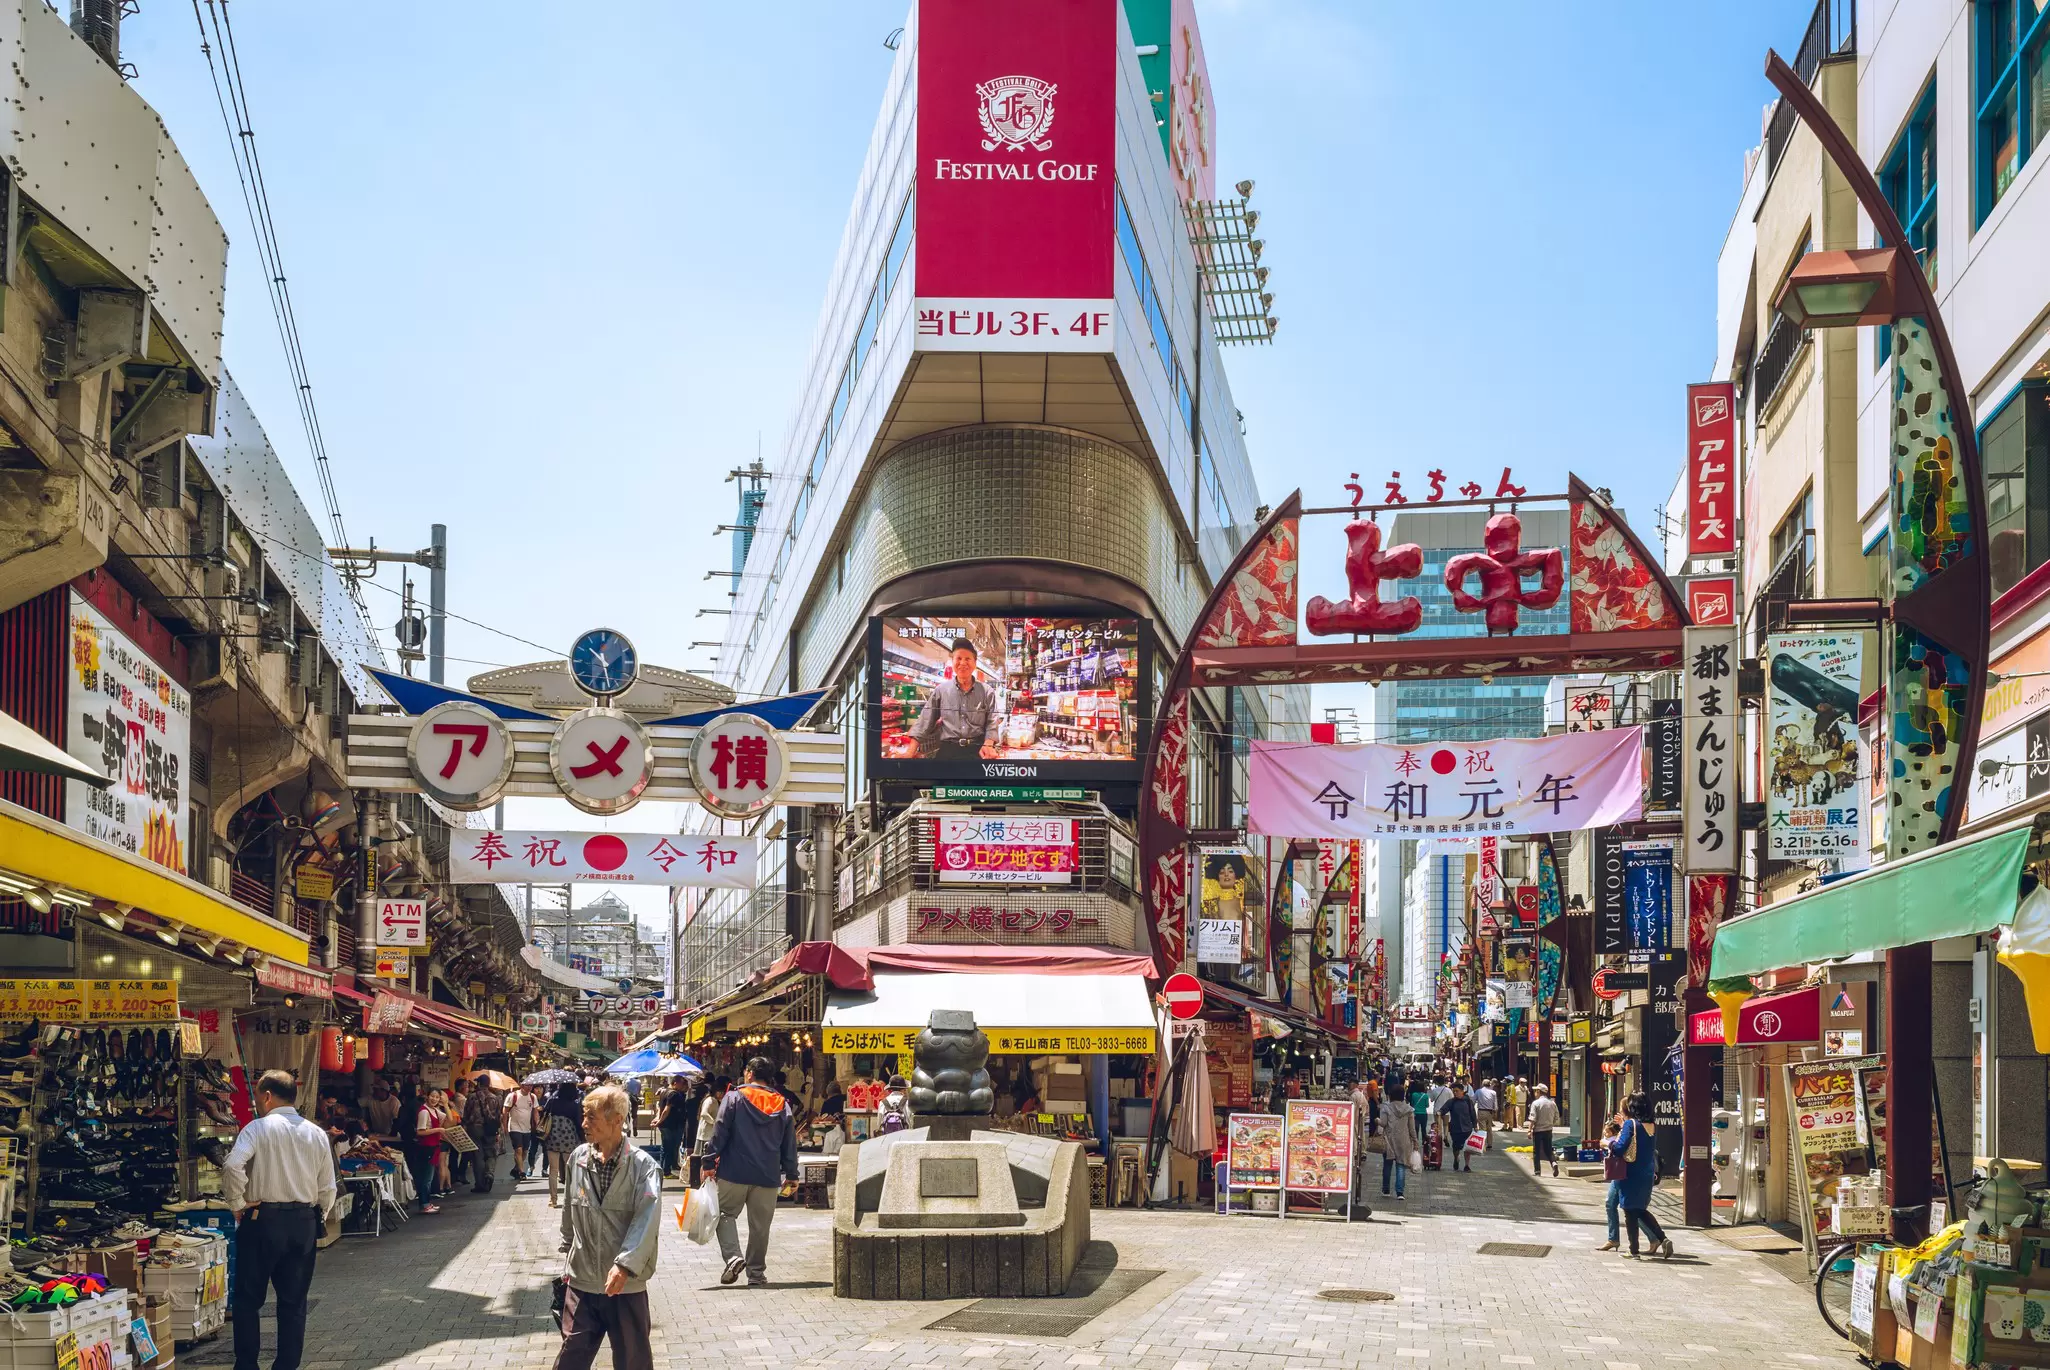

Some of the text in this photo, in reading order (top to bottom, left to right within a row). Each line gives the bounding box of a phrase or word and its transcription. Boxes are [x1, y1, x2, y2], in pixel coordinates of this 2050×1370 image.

[991, 77, 1044, 89] FESTIVAL GOLF
[935, 159, 1098, 181] FESTIVAL GOLF
[918, 310, 1002, 336] 当ビル
[1344, 467, 1528, 506] うえちゅん
[1699, 439, 1726, 541] アドアーズ
[1306, 513, 1565, 637] 上中
[1037, 629, 1122, 640] アメ横センタービル
[1780, 638, 1837, 648] ほっとタウンうえの
[1569, 695, 1611, 712] 名物
[1982, 678, 2022, 722] antra
[1692, 643, 1730, 852] 都まんじゅう
[83, 705, 179, 815] 一軒め酒場
[432, 723, 770, 791] アメ横
[1394, 749, 1495, 778] 奉祝
[1662, 721, 1674, 797] ROOMPIA
[996, 766, 1037, 777] VISION
[947, 789, 1014, 797] SMOKING AREA
[1312, 773, 1580, 823] 令和元年
[950, 820, 1064, 842] アメ横女学園
[1374, 820, 1517, 834] 上野中通商店街振興組合
[1774, 835, 1851, 848] 3.21 6.16
[469, 831, 738, 873] 奉祝 令和
[974, 851, 1064, 867] ロケ地です
[575, 872, 634, 882] アメ横商店街連合会
[969, 872, 1043, 881] アメ横センタービル
[1605, 843, 1620, 949] ROOMPIA
[382, 903, 421, 916] ATM
[1644, 868, 1656, 947] トゥーランドット
[917, 905, 1099, 933] アメ横センター
[1199, 920, 1240, 933] クリムト
[1229, 934, 1240, 945] 展
[24, 981, 50, 990] 大人気
[57, 981, 75, 990] 商品
[94, 981, 168, 990] 当店 大人気 商品
[1505, 982, 1531, 990] クリムト
[592, 1000, 656, 1012] アメ横
[1830, 1009, 1855, 1017] NAGAFUJI
[831, 1031, 896, 1050] たらばがに
[999, 1036, 1148, 1051] (株)石山商店 TEL03-3833-6668
[1794, 1073, 1855, 1097] バイキ
